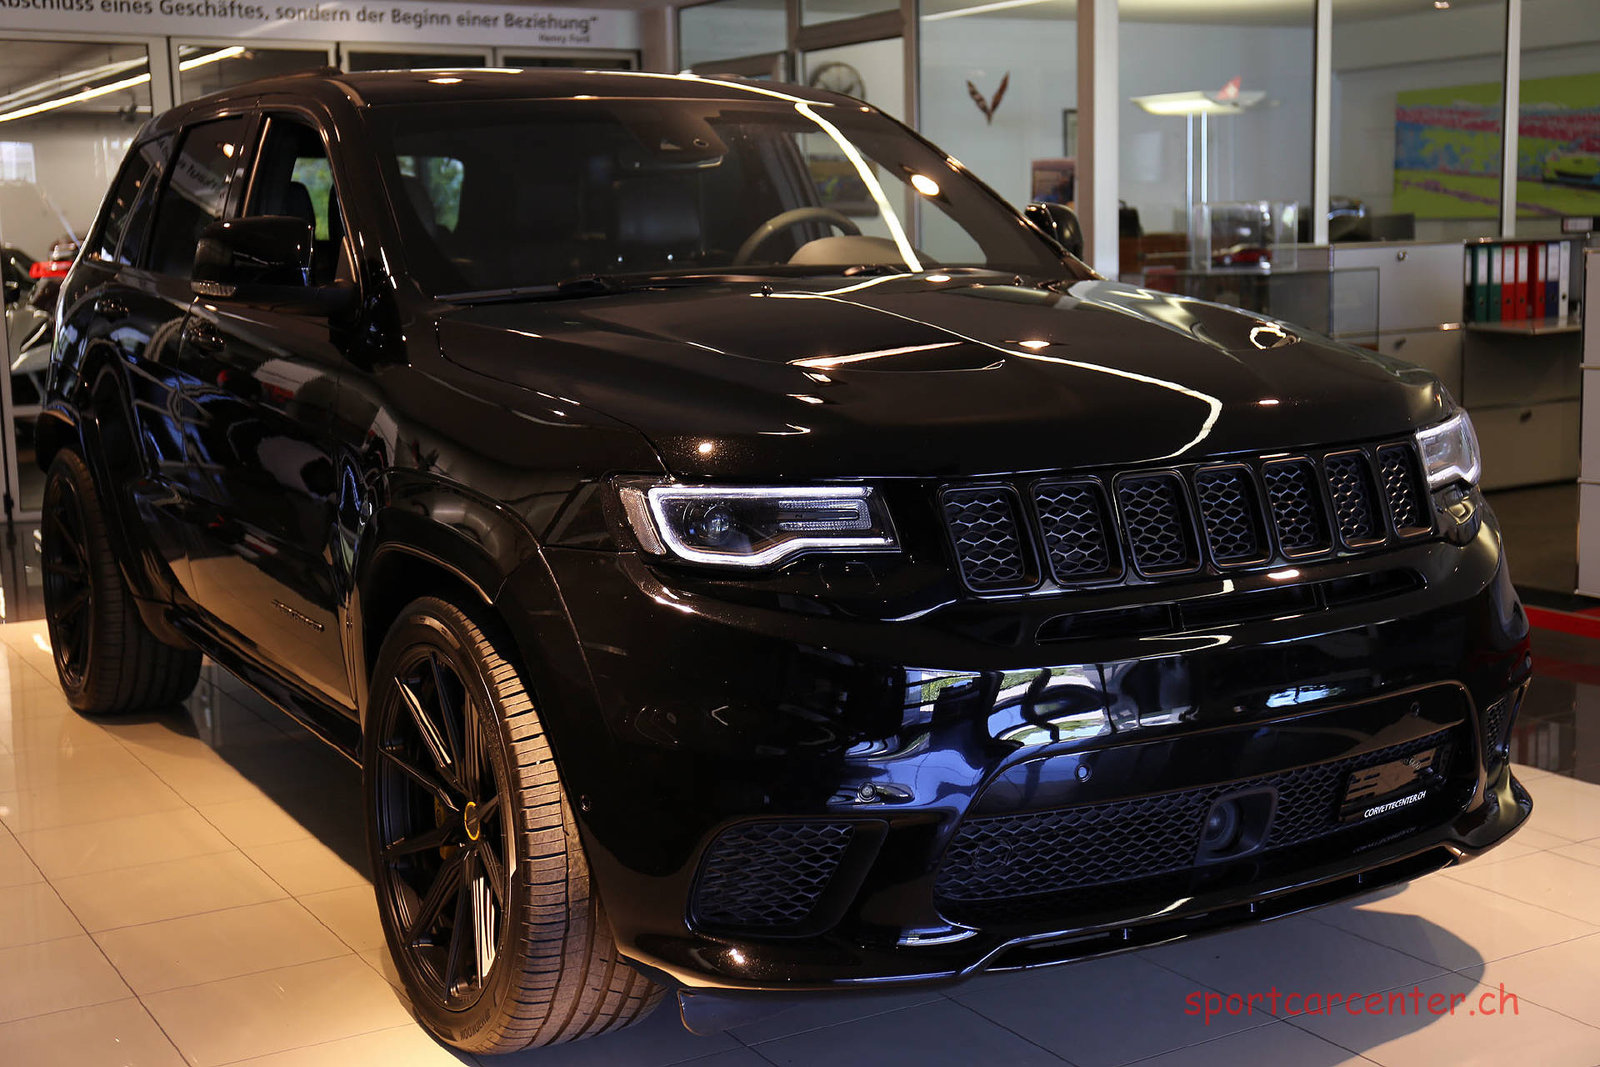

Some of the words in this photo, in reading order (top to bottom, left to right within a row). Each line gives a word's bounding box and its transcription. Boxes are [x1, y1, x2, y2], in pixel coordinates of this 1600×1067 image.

[0, 0, 94, 12] bschluss
[101, 0, 152, 14] eines
[160, 0, 269, 20] Geschäftes,
[275, 4, 350, 22] sondern
[357, 7, 385, 23] der
[391, 8, 451, 29] Beginn
[457, 11, 498, 27] einer
[1364, 790, 1427, 818] CORVETTECENTER.CH
